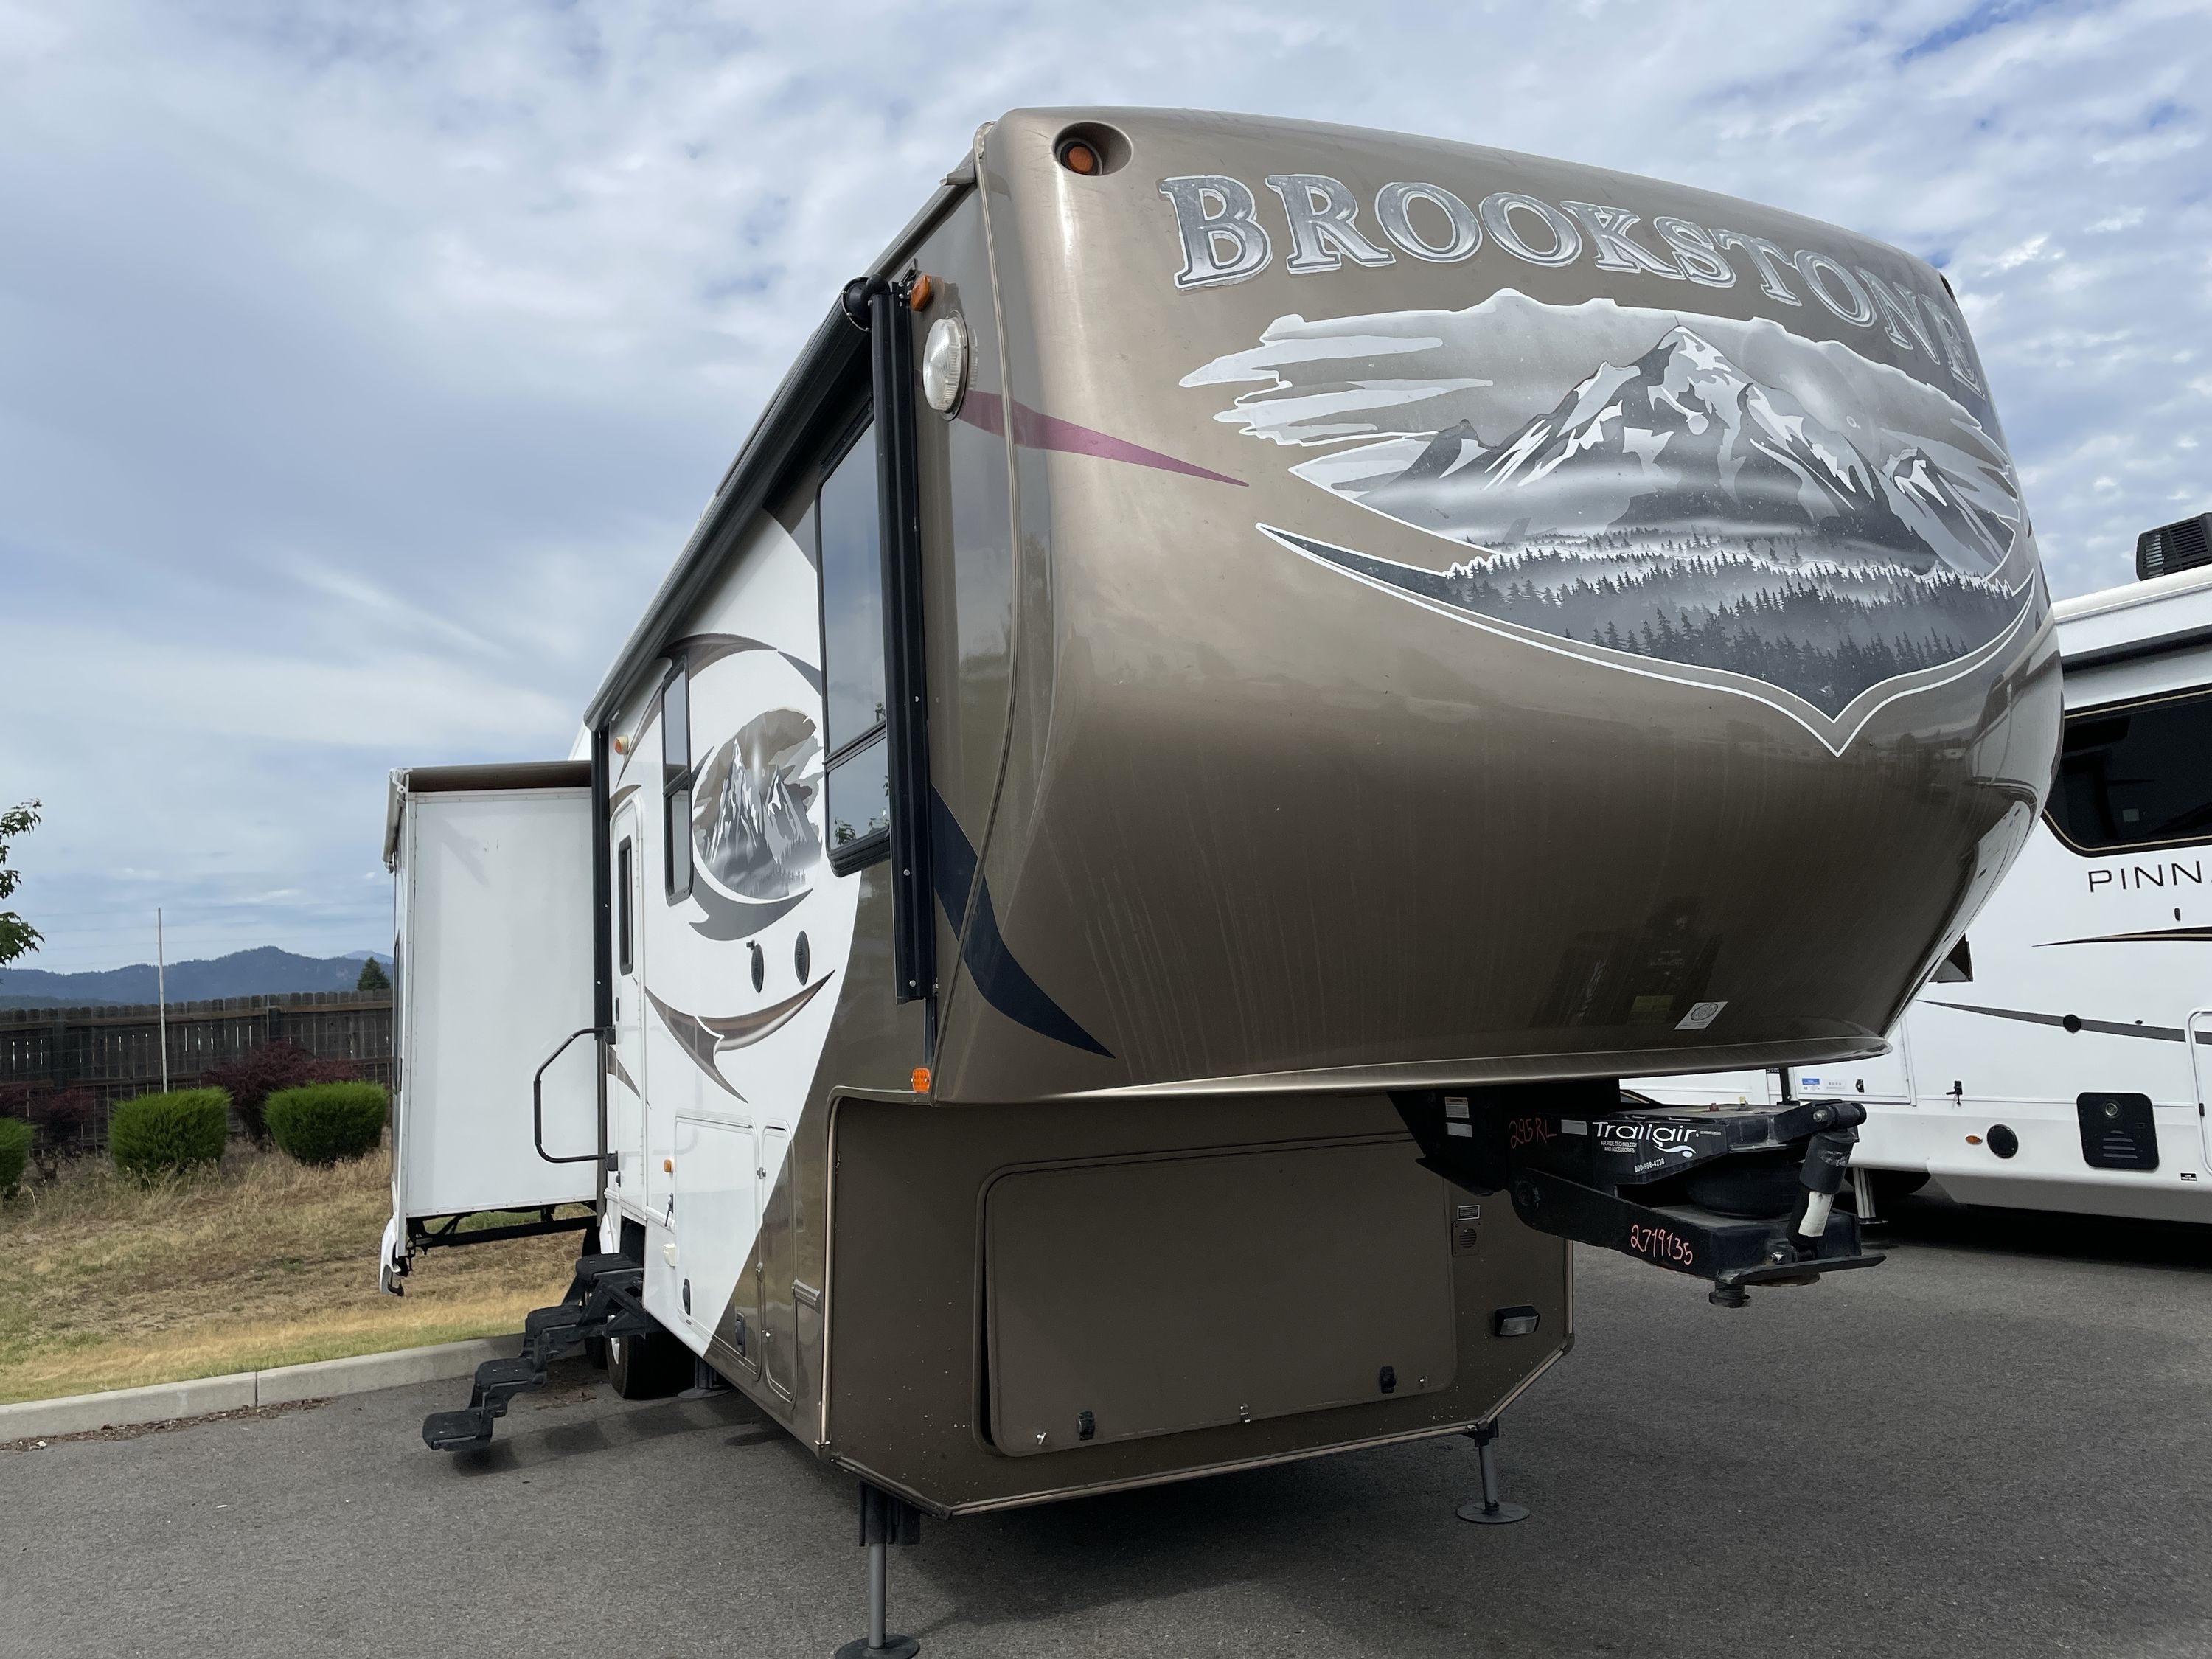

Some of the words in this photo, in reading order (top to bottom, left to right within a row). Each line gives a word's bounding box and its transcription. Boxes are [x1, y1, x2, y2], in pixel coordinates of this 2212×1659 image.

[1159, 173, 1985, 400] BROOKSTONE
[2088, 860, 2212, 893] PINN
[1630, 1224, 1693, 1265] 2719135
